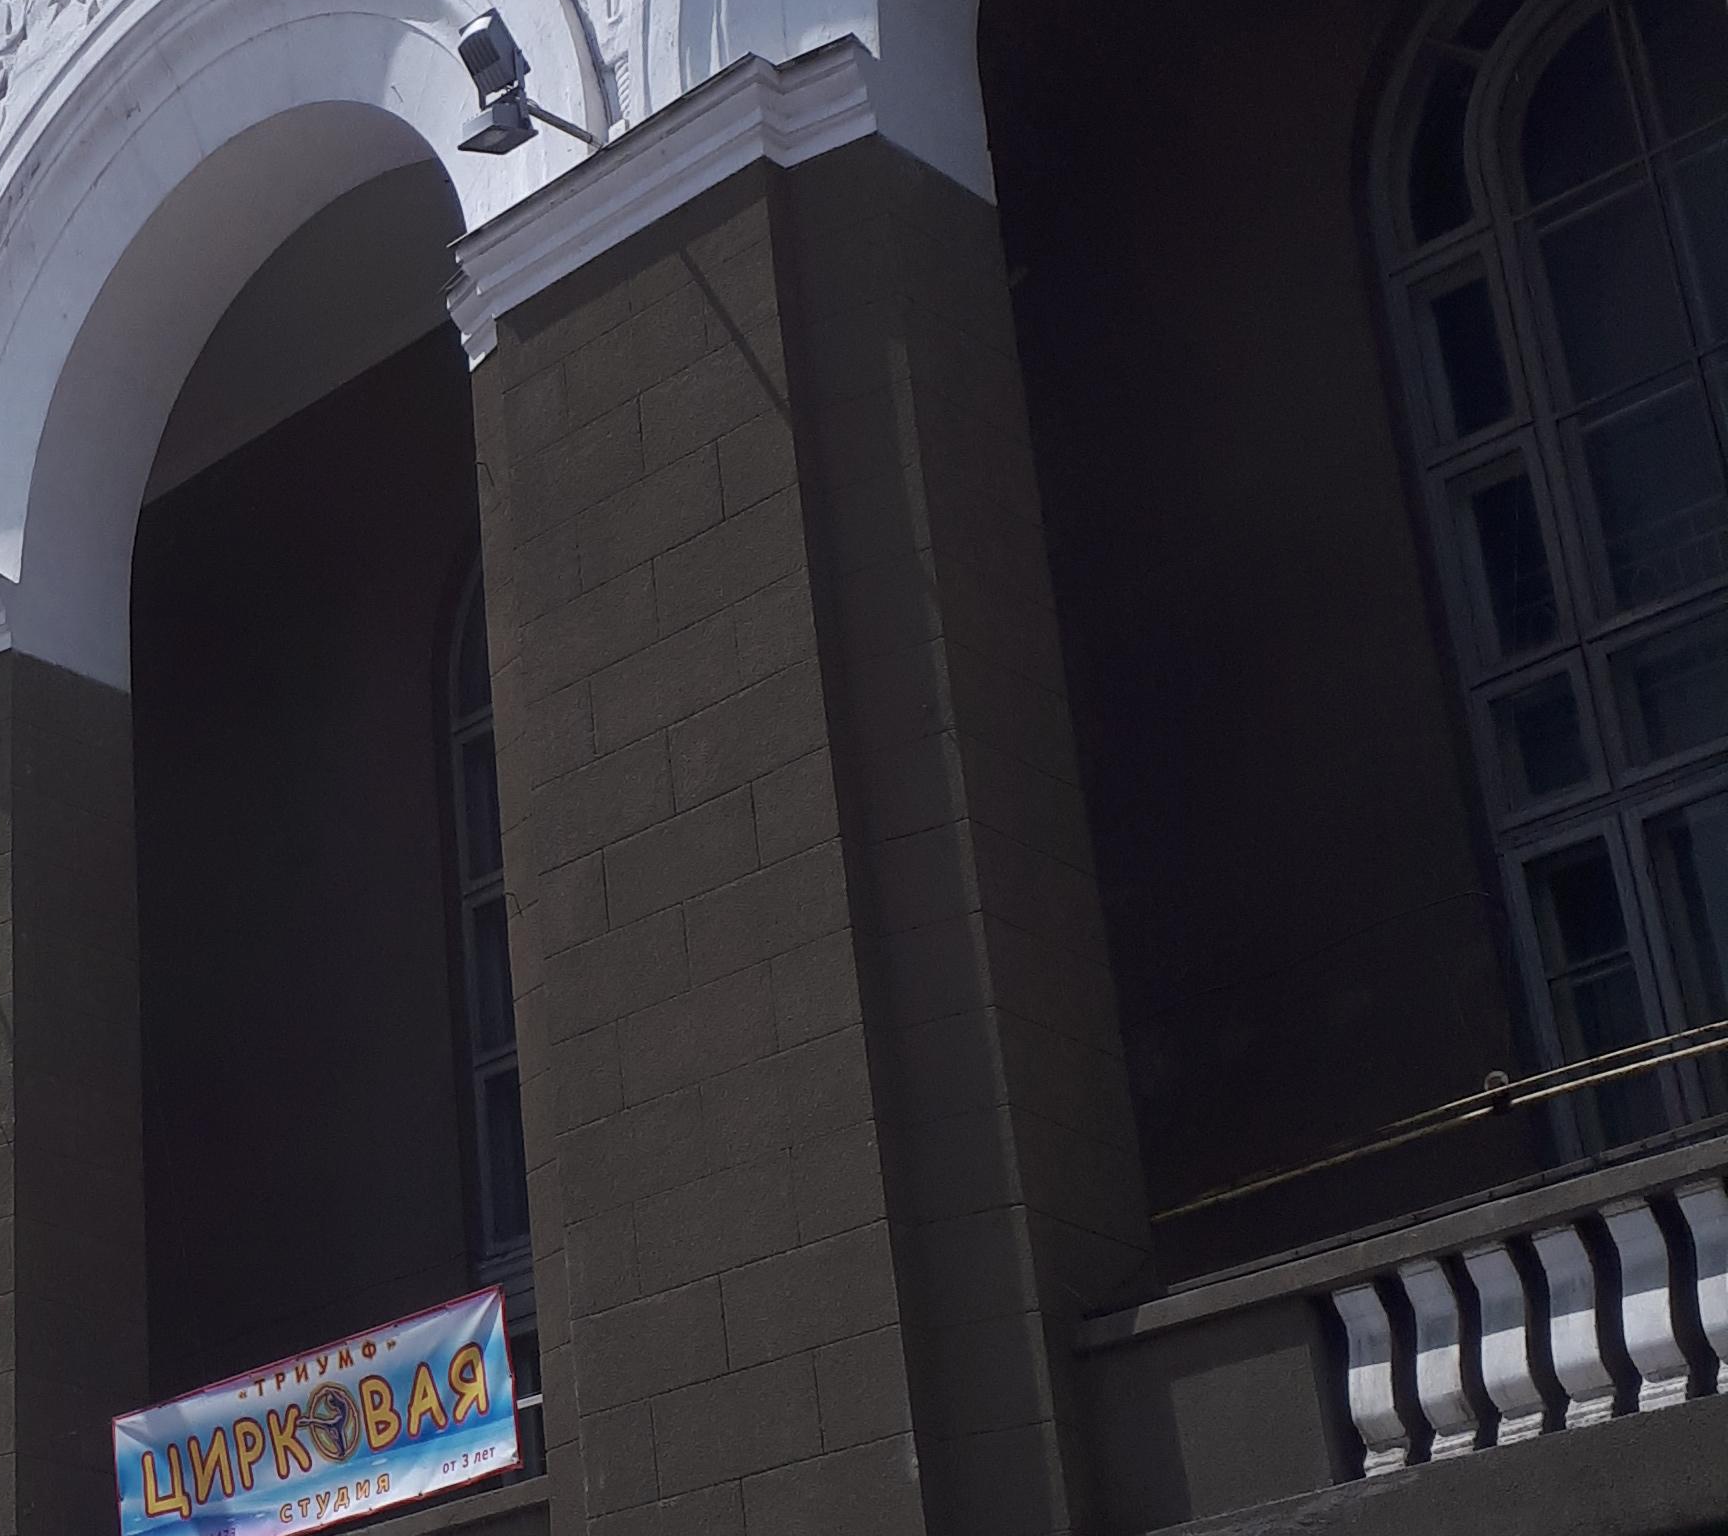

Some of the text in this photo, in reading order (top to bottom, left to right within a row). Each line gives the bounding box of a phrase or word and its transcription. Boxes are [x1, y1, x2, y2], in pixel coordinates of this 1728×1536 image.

[238, 1338, 398, 1401] «ТРИУМФ»
[141, 1341, 490, 1521] ЦИРКОВАЯ
[442, 1447, 496, 1474] от 3 лет
